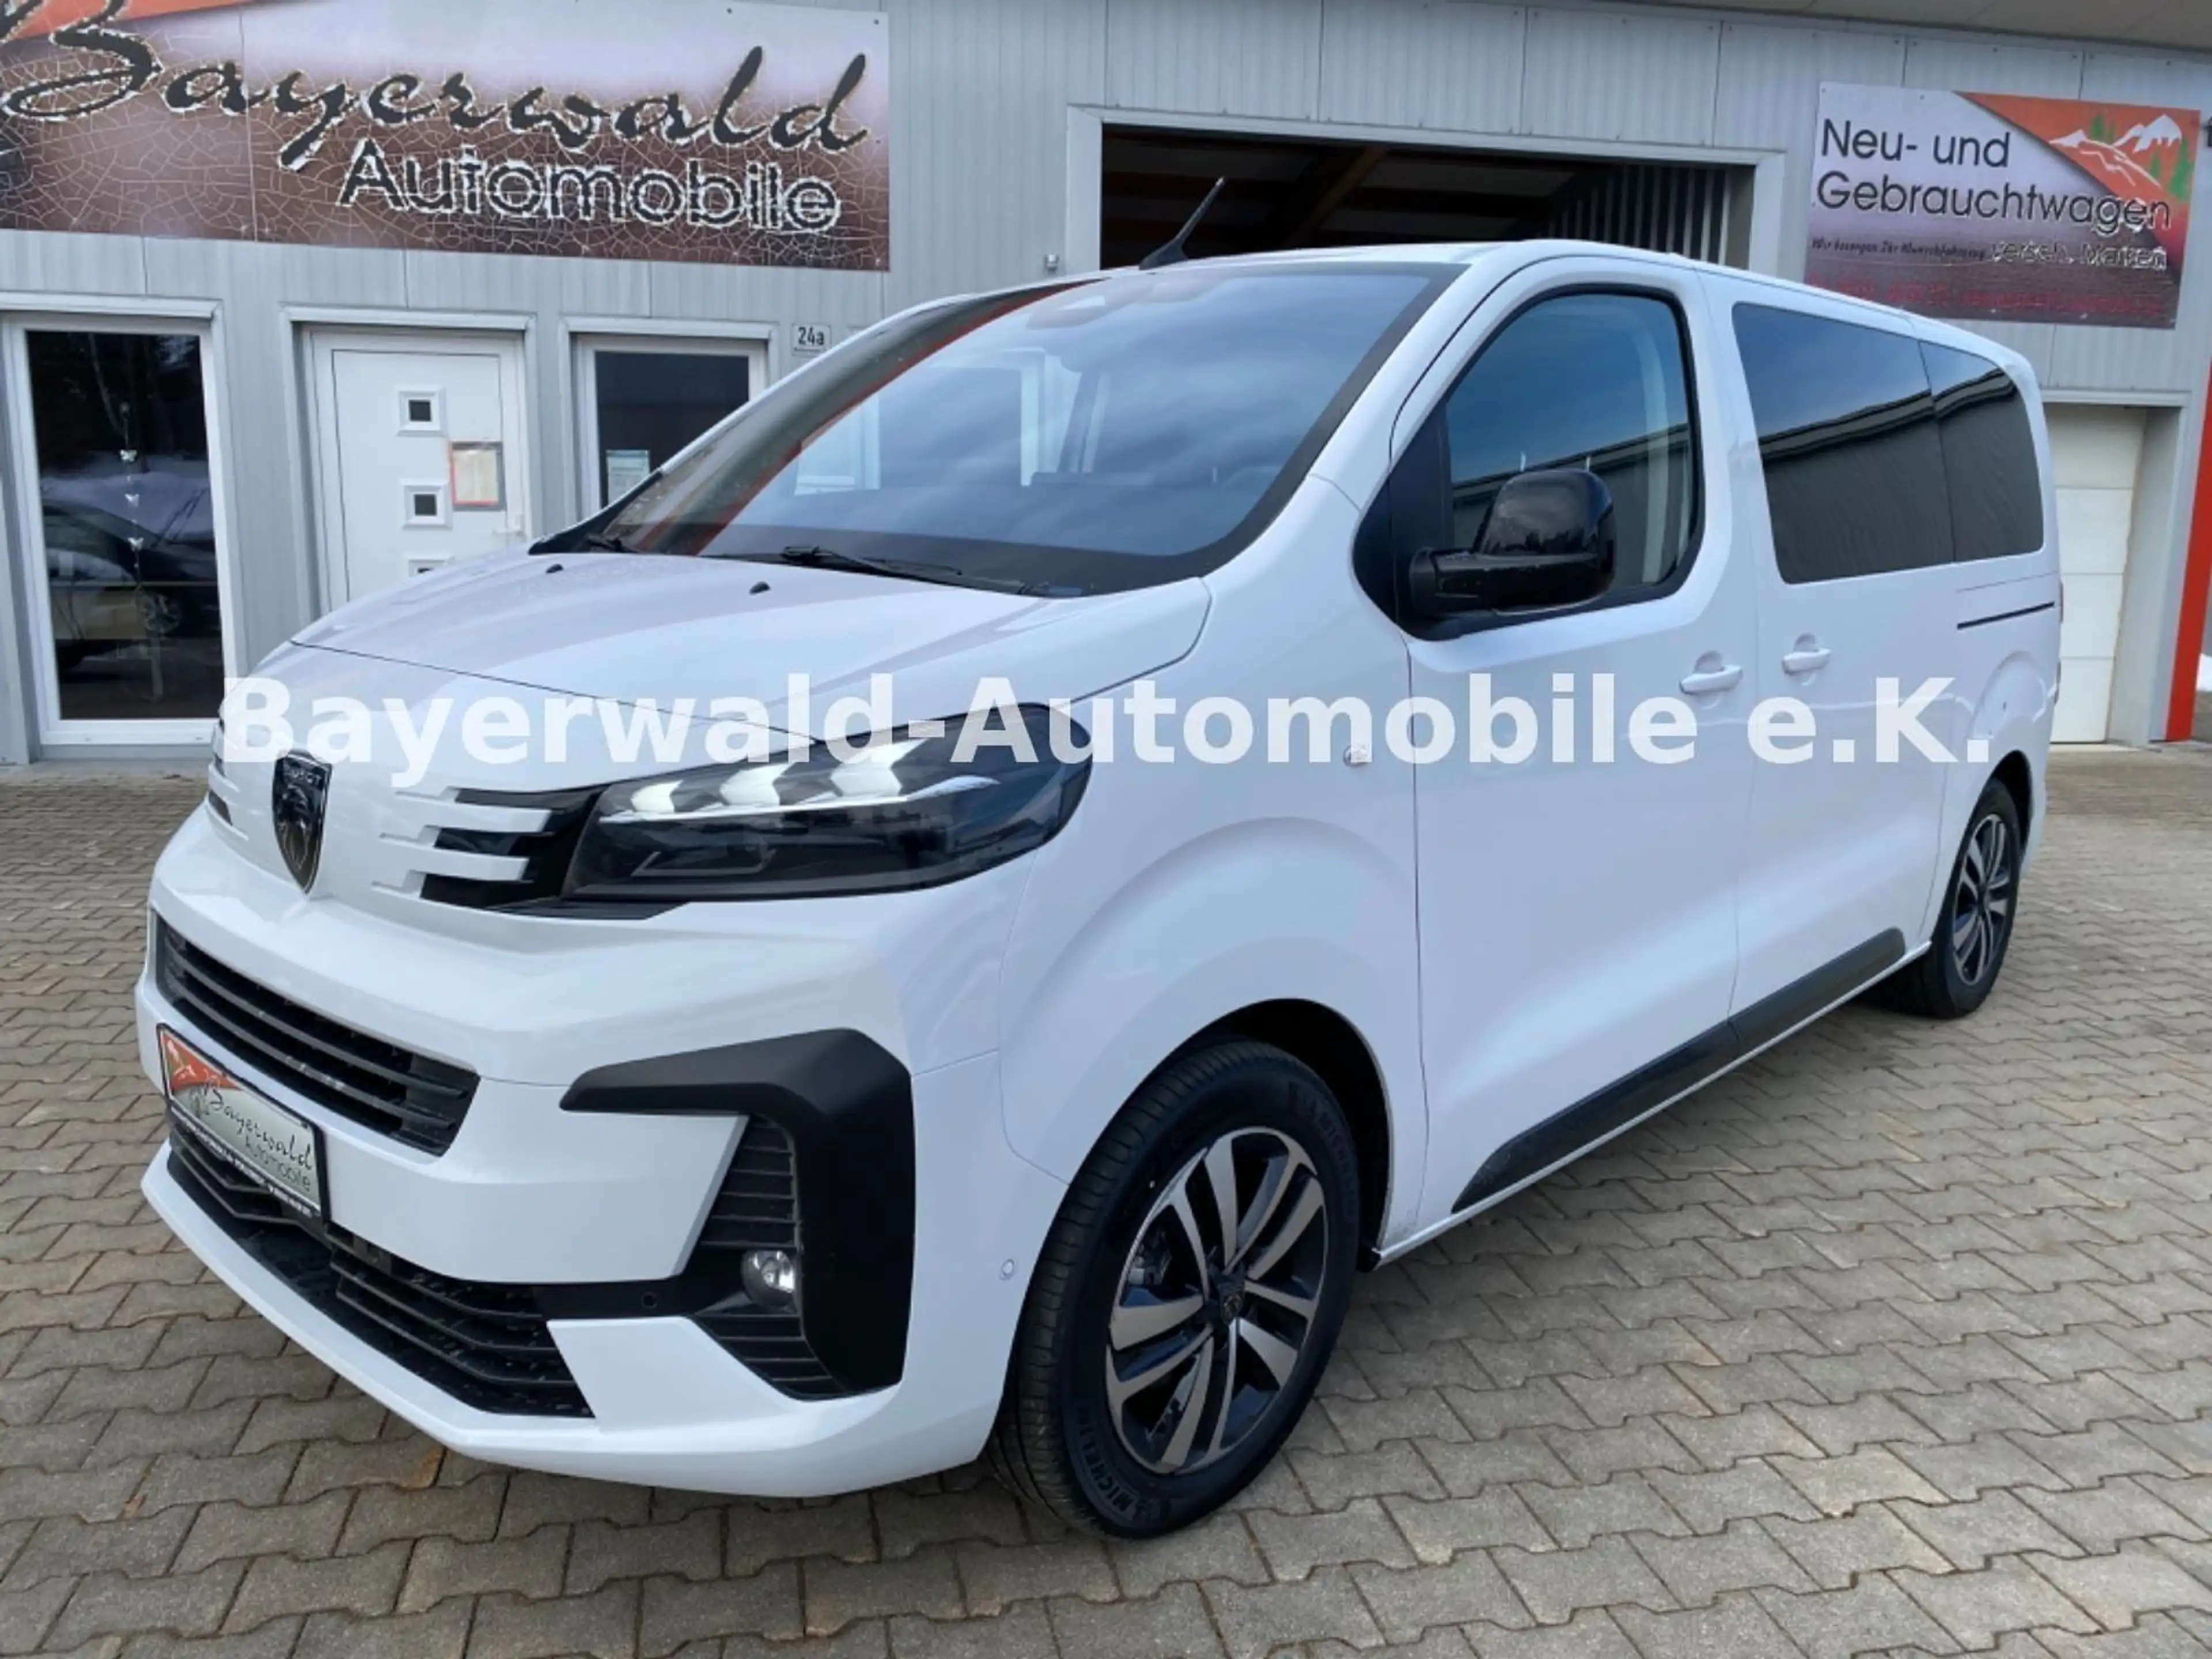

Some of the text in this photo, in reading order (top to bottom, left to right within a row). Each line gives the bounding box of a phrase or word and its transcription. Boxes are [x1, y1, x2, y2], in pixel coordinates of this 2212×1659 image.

[1820, 118, 2010, 168] Neu- und
[336, 138, 842, 233] Automobile
[1817, 170, 2172, 236] Gebrauchtwagen
[798, 326, 825, 346] 24a
